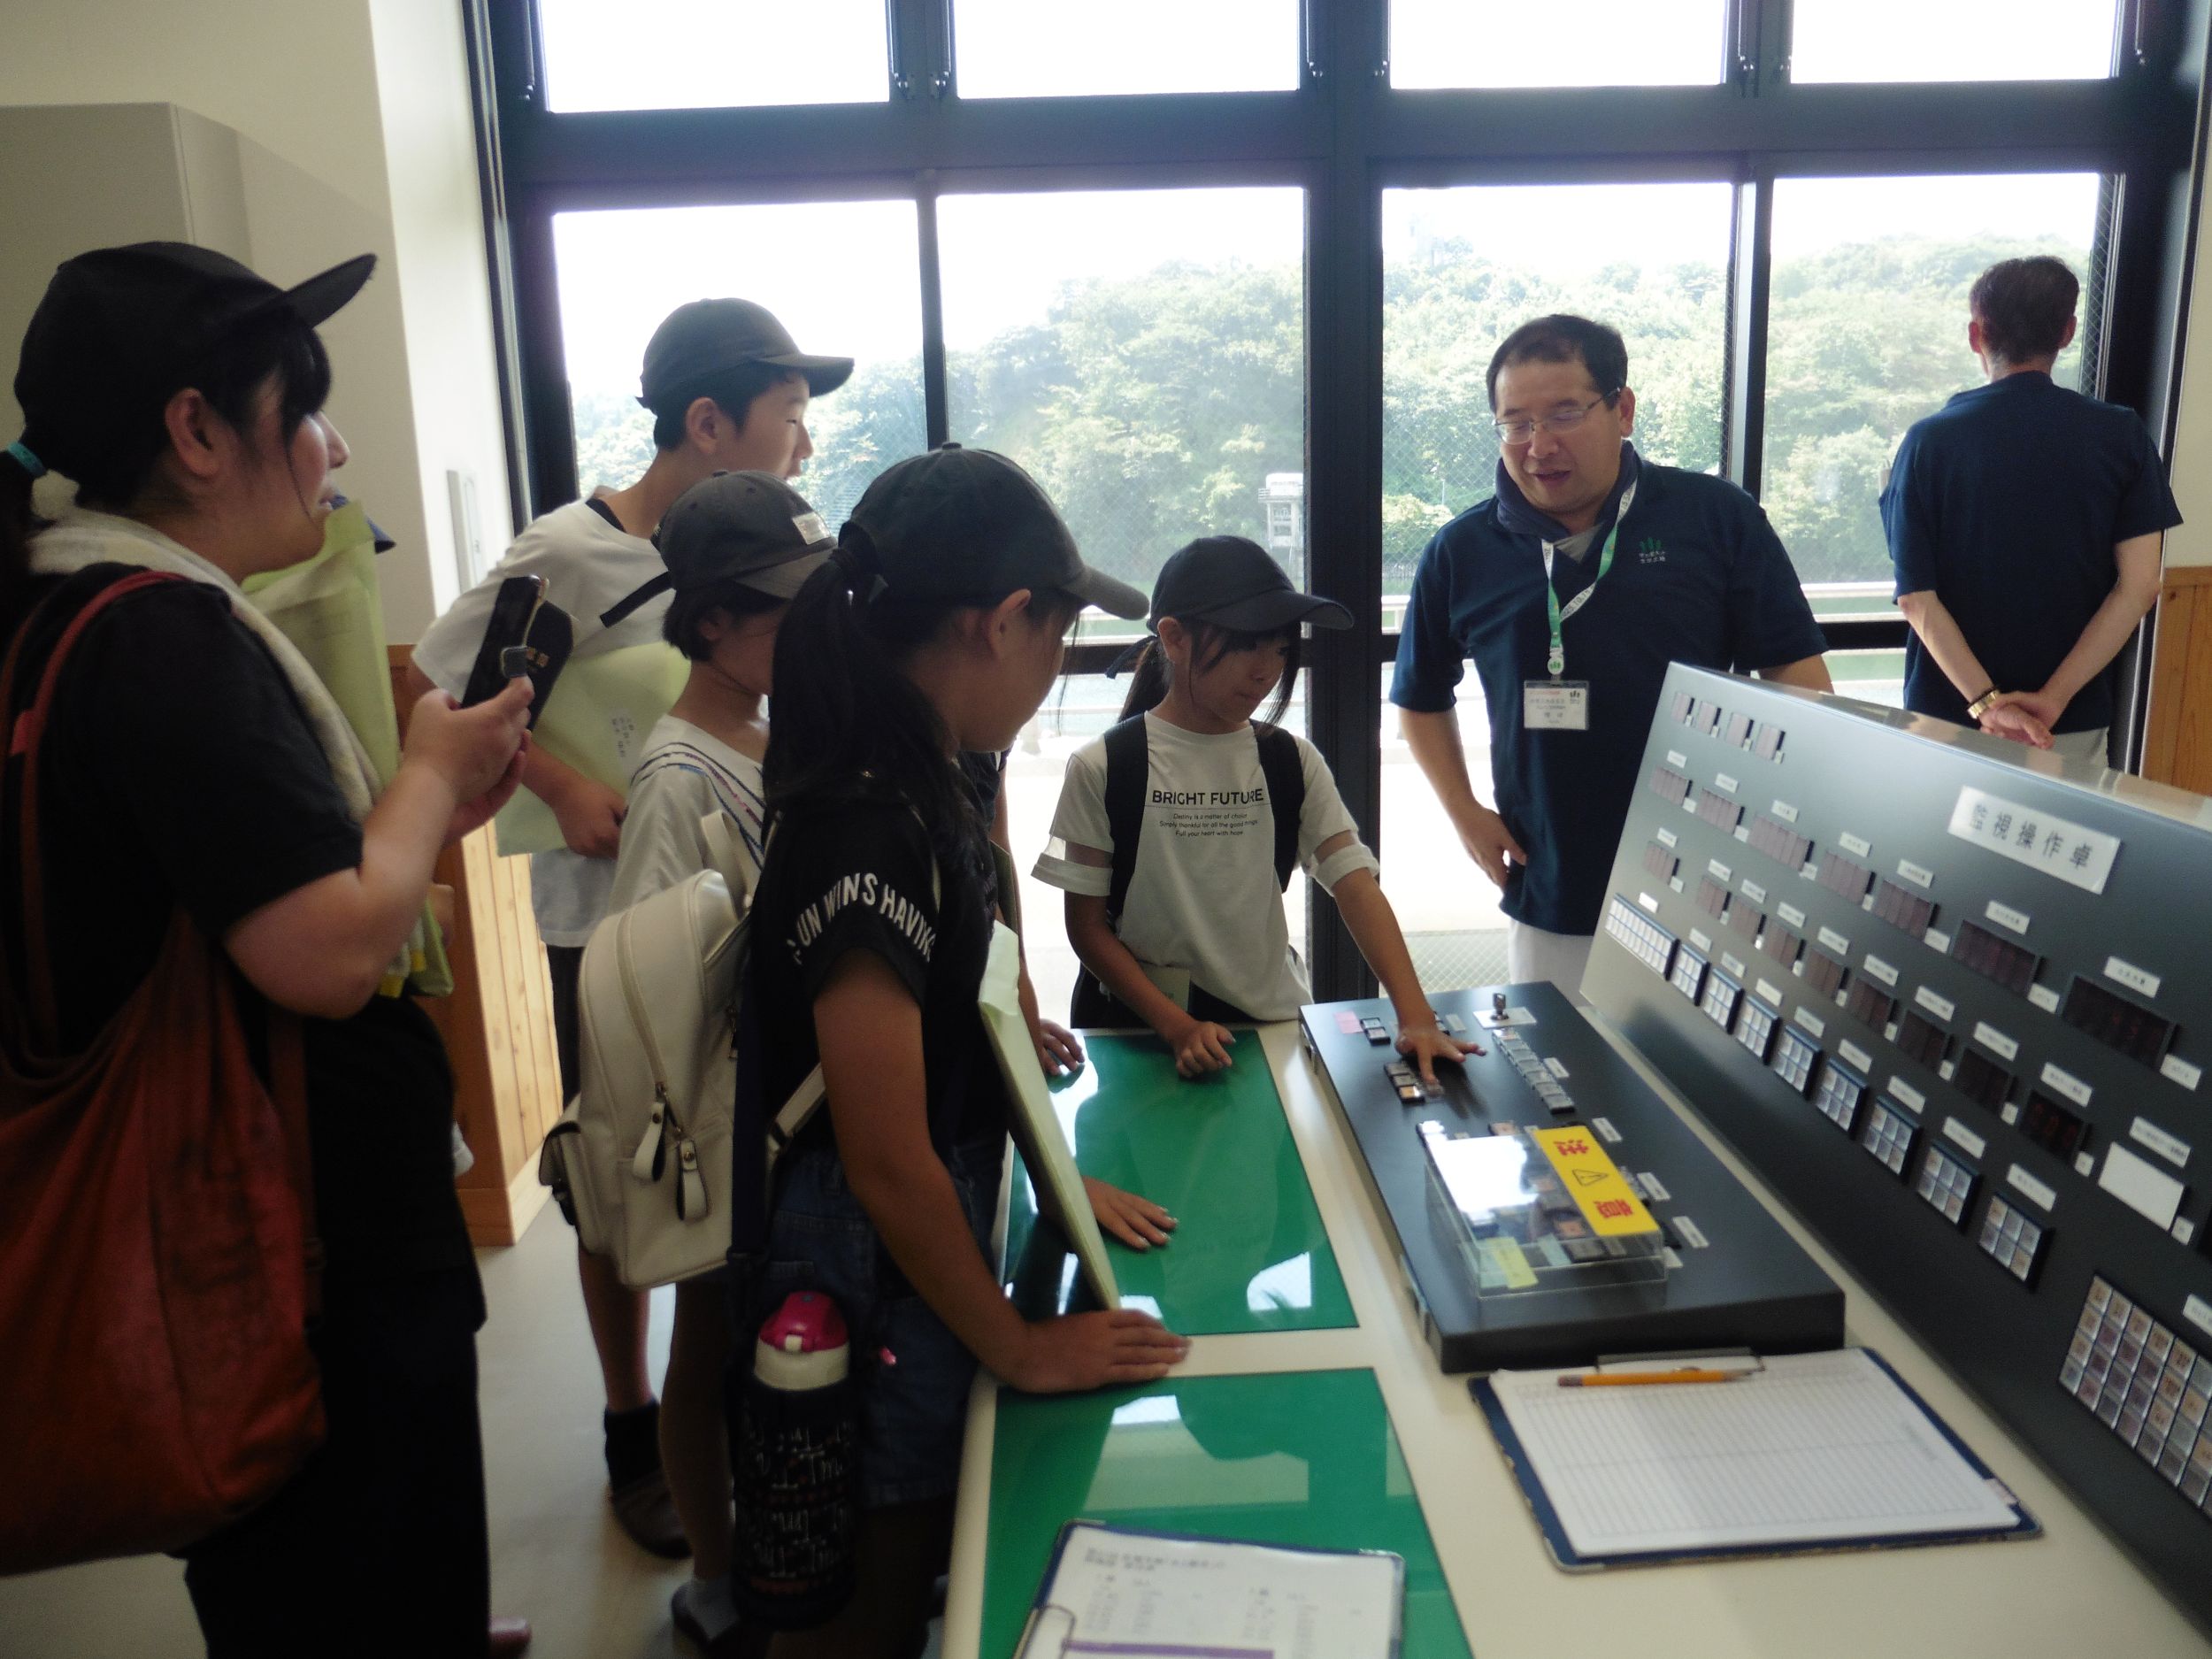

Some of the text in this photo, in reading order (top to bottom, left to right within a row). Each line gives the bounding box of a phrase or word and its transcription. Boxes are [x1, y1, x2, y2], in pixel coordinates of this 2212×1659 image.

[1152, 787, 1264, 805] BRIGHT FUTURE
[824, 872, 879, 923] WINS
